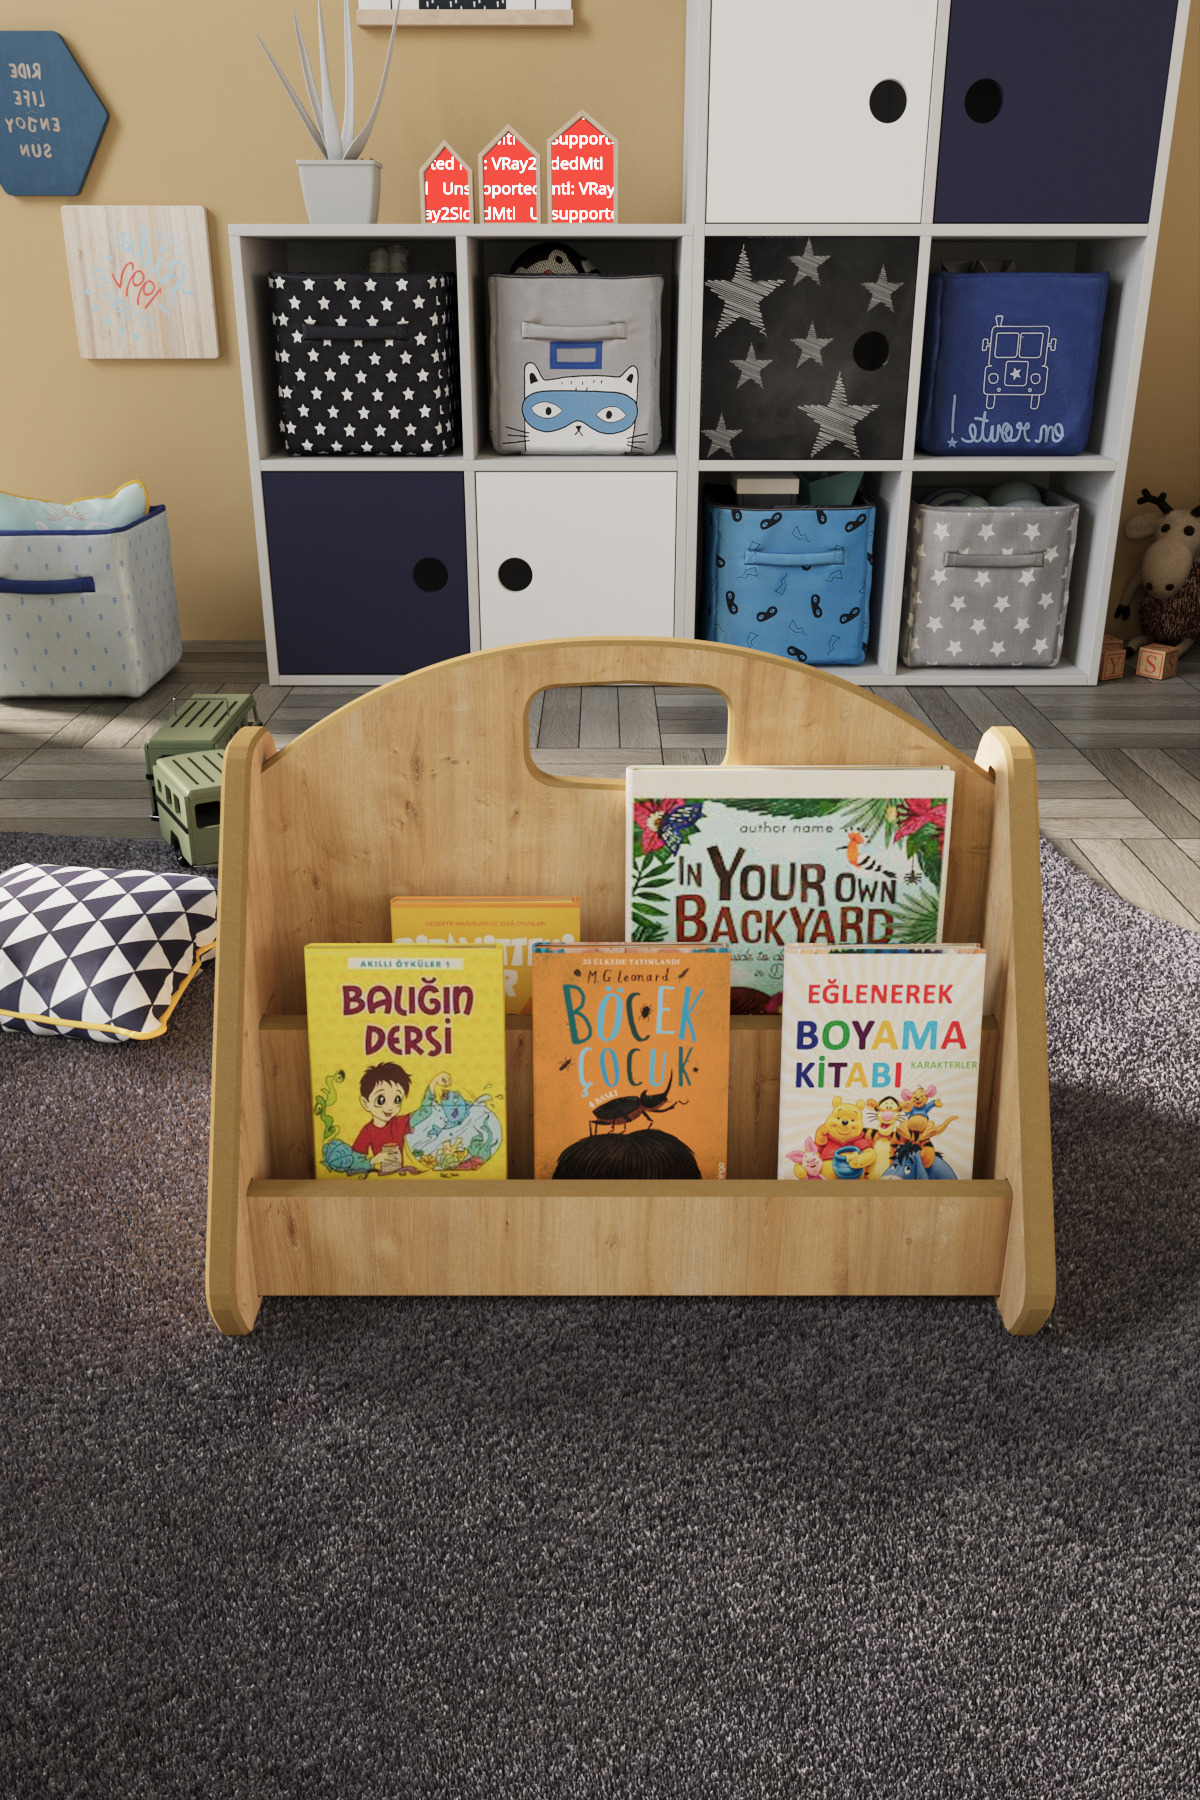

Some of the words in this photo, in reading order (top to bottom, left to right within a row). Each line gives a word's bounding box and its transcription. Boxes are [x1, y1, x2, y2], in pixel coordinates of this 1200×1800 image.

[1144, 654, 1157, 674] S
[739, 821, 787, 834] author
[792, 825, 834, 834] name
[678, 856, 702, 888] IN
[707, 845, 826, 907] YOUR
[835, 872, 897, 904] OWN
[675, 894, 896, 947] BACKYARD
[617, 967, 670, 983] Leonard
[808, 978, 954, 1004] EĞLENEREK
[341, 976, 474, 1017] BALIĞIN
[562, 983, 705, 1044] BÖCEK
[364, 1017, 453, 1057] DERSİ
[796, 1020, 967, 1050] BOYAMA
[577, 1046, 693, 1098] ÇOCUK
[795, 1055, 902, 1088] KİTABI
[910, 1061, 978, 1070] KARAKTERLER
